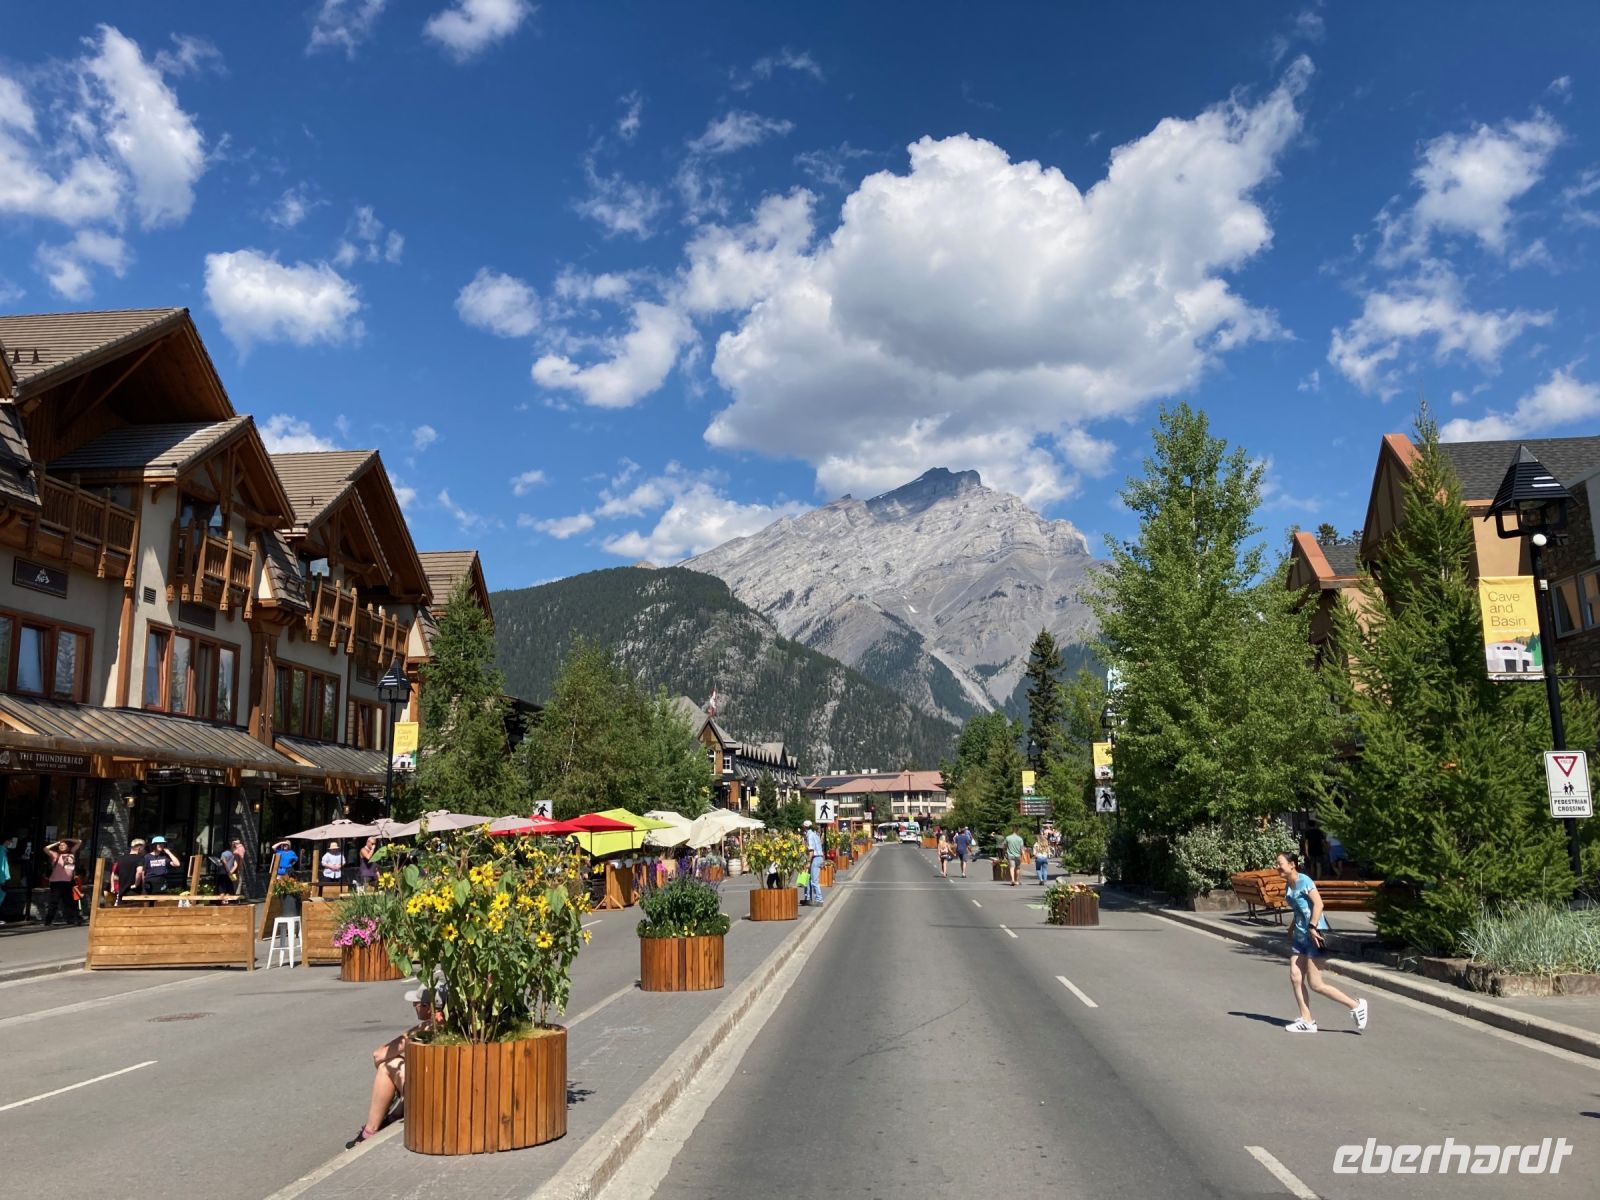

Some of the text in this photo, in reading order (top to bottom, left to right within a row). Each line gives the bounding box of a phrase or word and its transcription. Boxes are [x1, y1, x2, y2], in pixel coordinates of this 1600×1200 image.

[1488, 591, 1520, 602] Cave
[1490, 603, 1514, 614] and
[1491, 615, 1526, 627] Basin
[20, 752, 33, 761] THE
